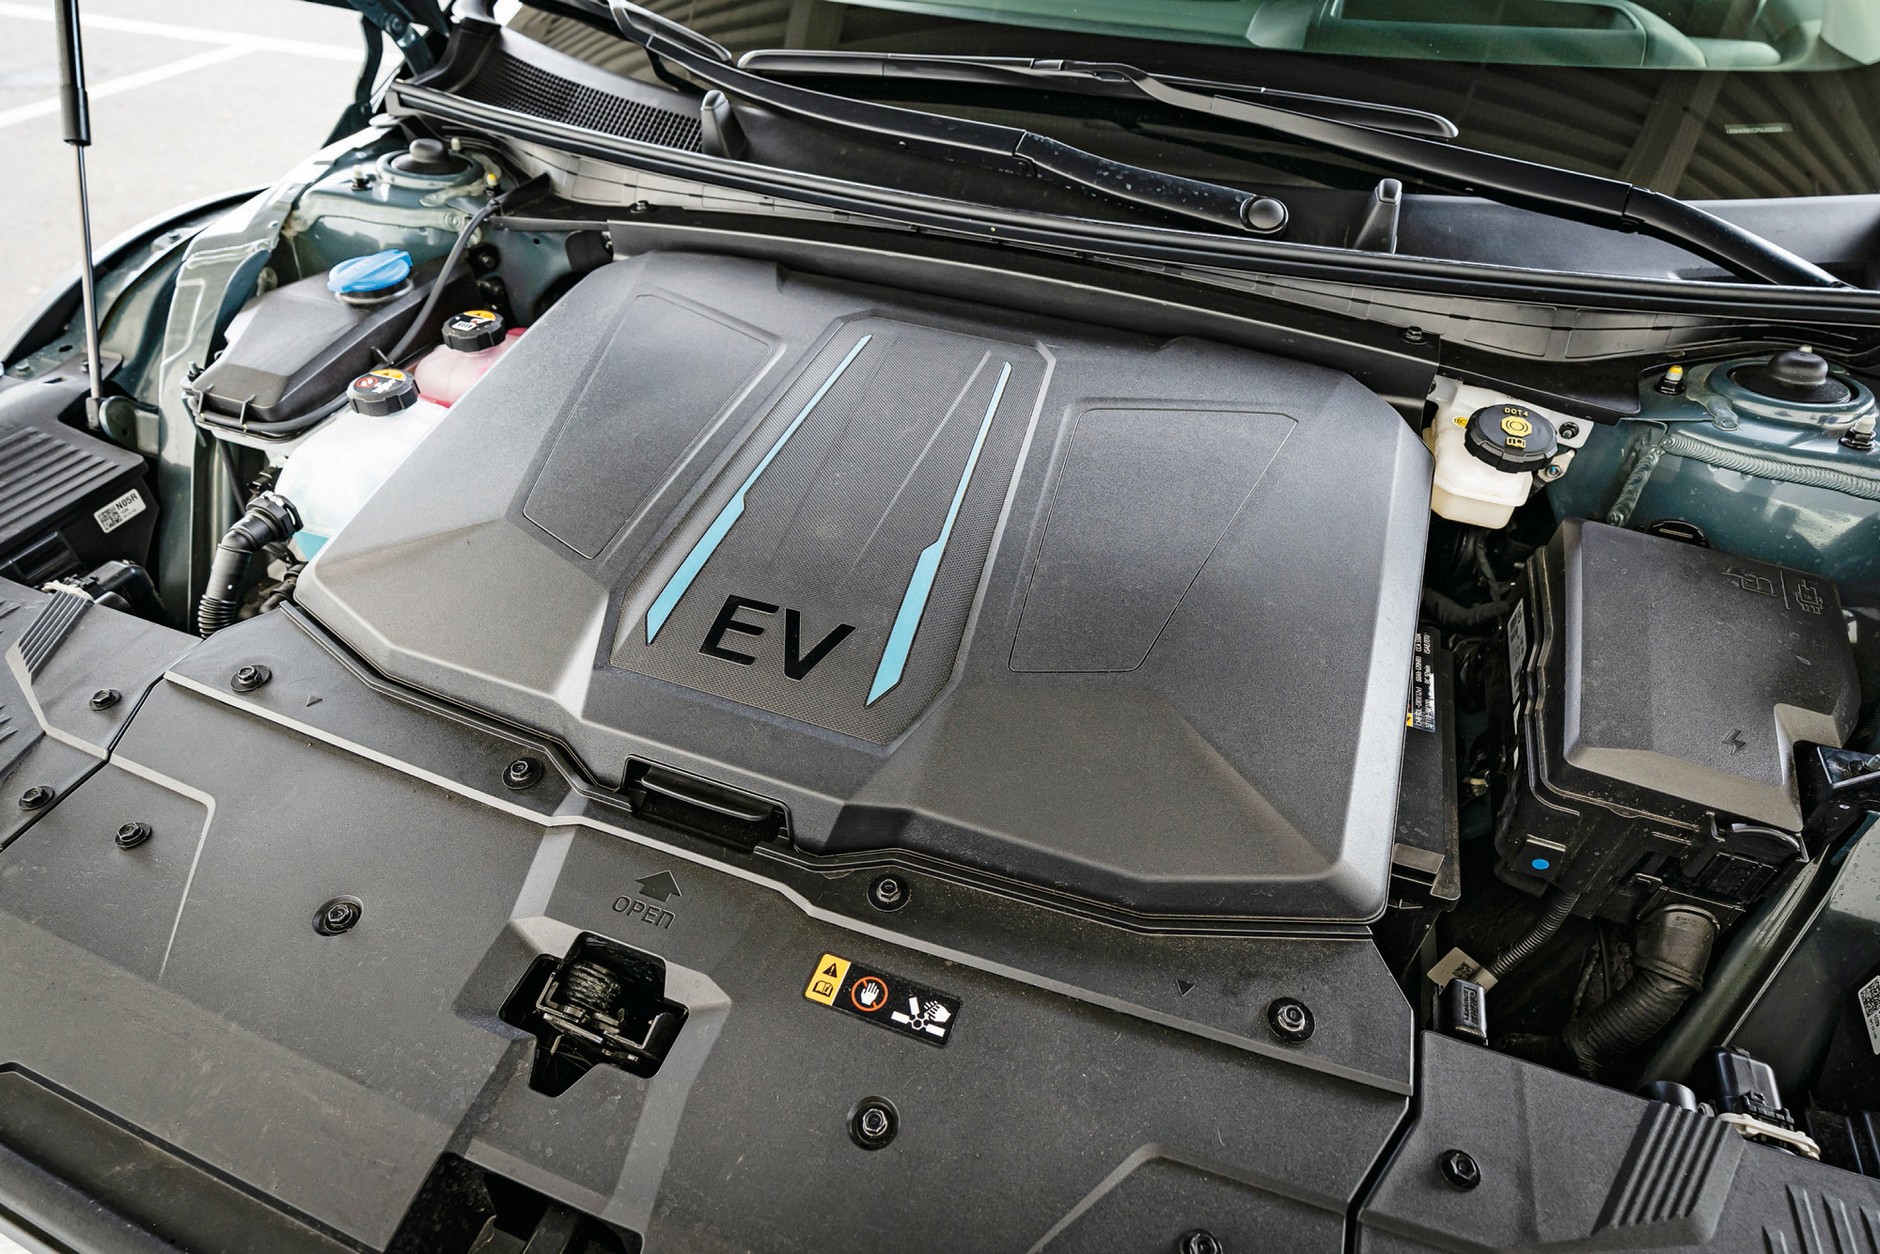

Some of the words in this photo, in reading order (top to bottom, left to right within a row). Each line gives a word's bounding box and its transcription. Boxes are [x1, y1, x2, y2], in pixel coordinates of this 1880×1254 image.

[1504, 407, 1522, 416] DOT
[115, 492, 138, 510] N05R
[698, 594, 857, 682] EV
[612, 894, 676, 930] OPEN
